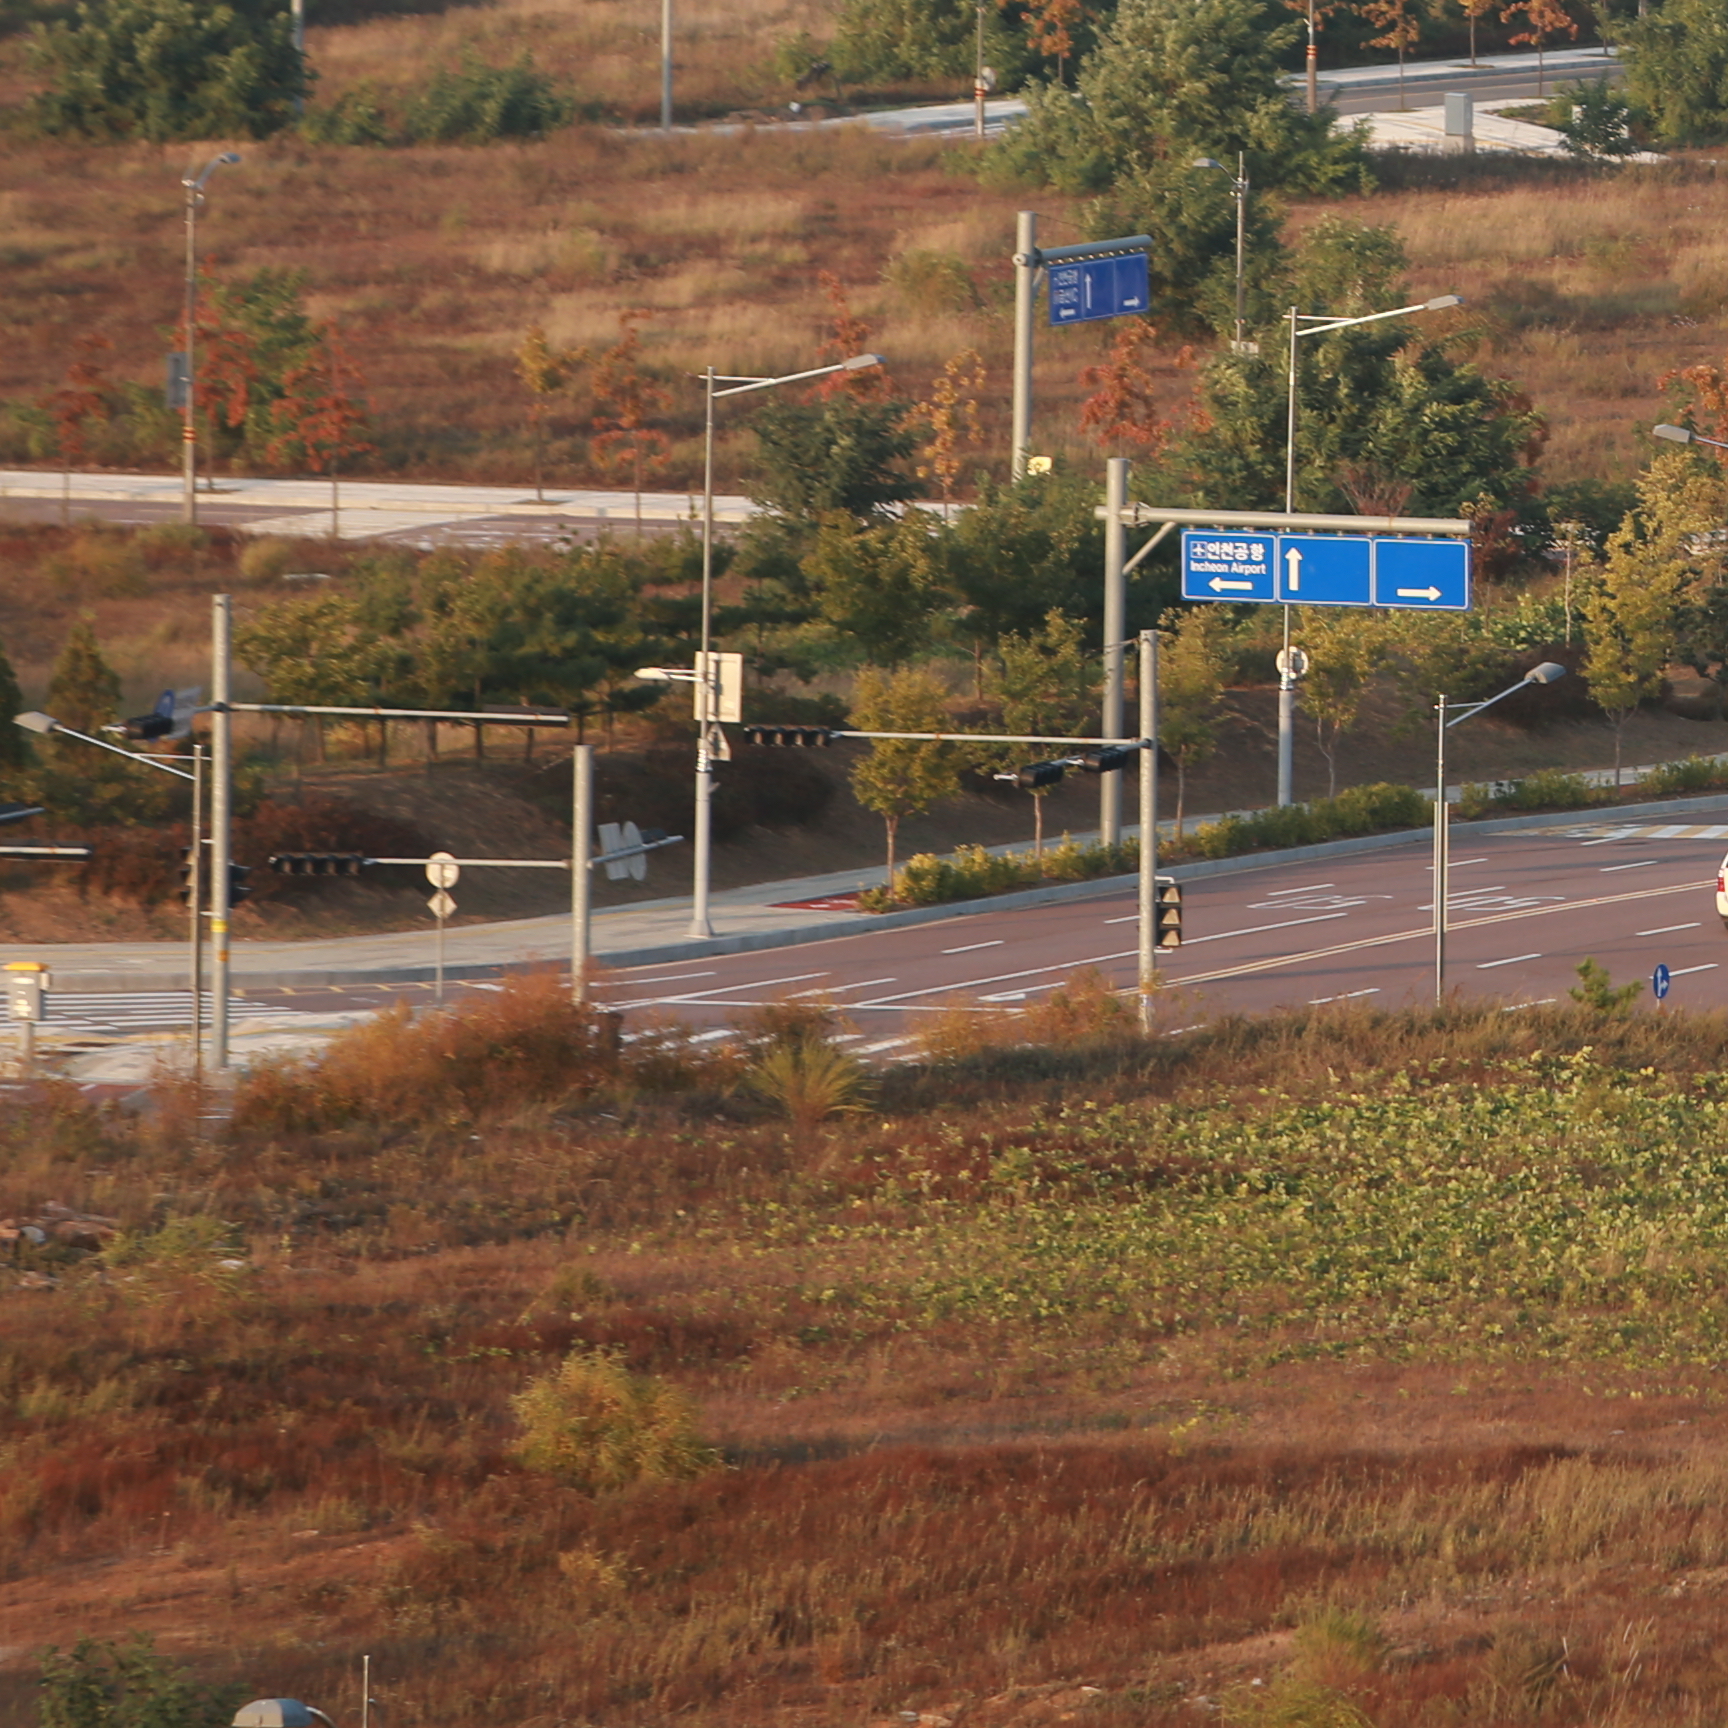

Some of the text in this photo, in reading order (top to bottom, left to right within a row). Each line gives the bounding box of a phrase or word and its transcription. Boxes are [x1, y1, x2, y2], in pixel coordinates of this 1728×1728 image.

[1207, 541, 1266, 562] 인천공항
[1190, 560, 1267, 576] Incheon Airport
